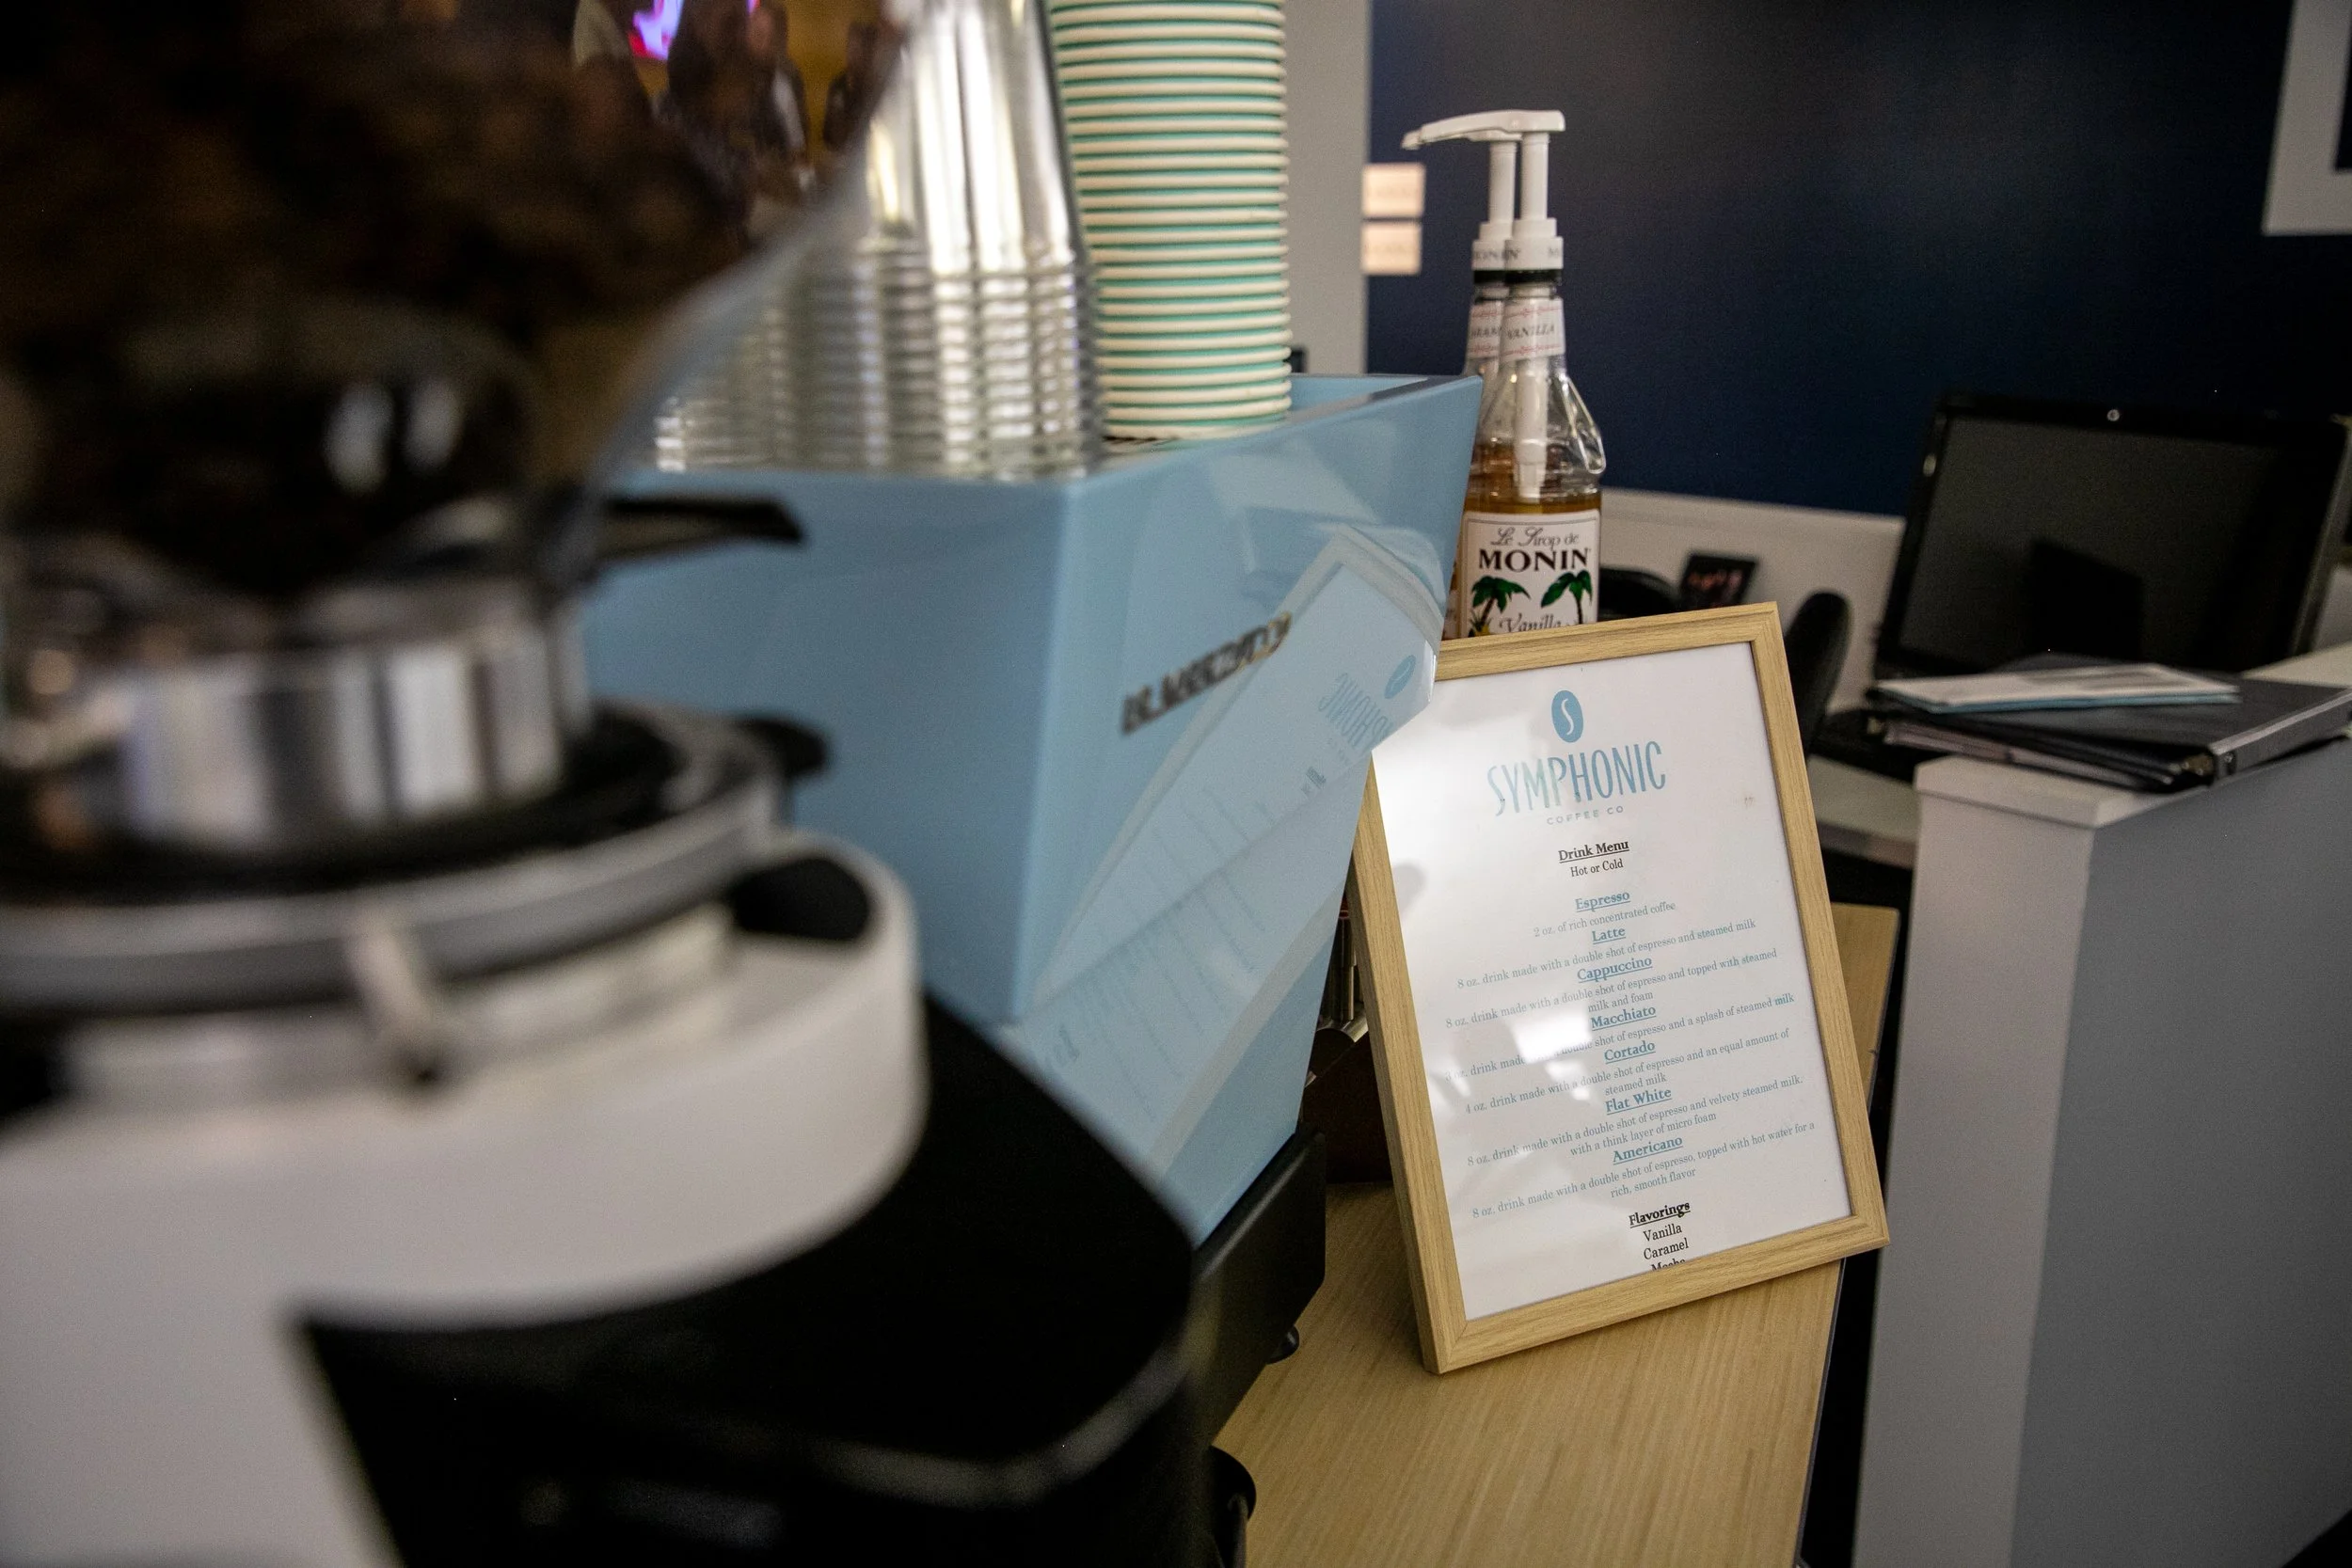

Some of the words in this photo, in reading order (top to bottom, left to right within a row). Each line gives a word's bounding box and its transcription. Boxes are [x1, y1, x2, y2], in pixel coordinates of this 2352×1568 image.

[1490, 526, 1516, 546] Le
[1518, 526, 1561, 549] Sirop
[1565, 532, 1580, 545] de
[1479, 548, 1588, 572] MONIN
[1486, 740, 1665, 816] SYMPHONIC
[1546, 809, 1600, 826] COFFEE
[1607, 805, 1624, 816] CO
[1557, 844, 1597, 864] Drink
[1595, 841, 1630, 858] Menu
[1569, 865, 1589, 878] Hot
[1589, 864, 1601, 874] or
[1601, 857, 1625, 872] Cold
[1574, 891, 1631, 913] Espresso
[1533, 927, 1541, 938] 2
[1541, 926, 1556, 936] oz.
[1556, 920, 1567, 933] of
[1567, 917, 1588, 931] rich
[1588, 904, 1649, 927] concentrated
[1649, 900, 1677, 914] coffee
[1591, 927, 1627, 945] Latte
[1456, 978, 1465, 990] 8
[1465, 978, 1481, 988] oz.
[1482, 969, 1511, 985] drink
[1511, 963, 1538, 978] made
[1539, 958, 1564, 972] with
[1563, 958, 1571, 968] a
[1571, 949, 1604, 966] double
[1605, 945, 1627, 958] shot
[1626, 942, 1637, 955] of
[1637, 937, 1677, 952] espresso
[1677, 929, 1696, 943] and
[1695, 922, 1735, 940] steamed
[1735, 917, 1757, 932] milk
[1576, 957, 1654, 984] Cappuccino
[1445, 1017, 1454, 1029] 8
[1453, 1017, 1470, 1027] oz.
[1470, 1007, 1500, 1023] drink
[1500, 1002, 1528, 1017] made
[1528, 996, 1552, 1011] with
[1552, 997, 1561, 1006] a
[1561, 988, 1596, 1005] double
[1594, 984, 1615, 997] shot
[1616, 979, 1627, 991] of
[1627, 974, 1667, 990] espresso
[1667, 966, 1686, 981] and
[1686, 959, 1719, 977] topped
[1718, 956, 1740, 969] with
[1740, 947, 1778, 965] steamed
[1587, 998, 1611, 1014] milk
[1611, 993, 1629, 1008] and
[1629, 991, 1654, 1004] foam
[1590, 1006, 1658, 1032] Macchiato
[1470, 1060, 1499, 1076] drink
[1594, 1034, 1616, 1048] shot
[1615, 1030, 1627, 1042] of
[1627, 1023, 1667, 1040] espresso
[1668, 1016, 1687, 1031] and
[1686, 1017, 1694, 1026] a
[1694, 1008, 1724, 1025] splash
[1724, 1005, 1735, 1017] of
[1735, 996, 1773, 1015] steamed
[1773, 992, 1795, 1006] milk
[1603, 1039, 1657, 1065] Cortado
[1472, 1101, 1488, 1113] oz.
[1489, 1092, 1518, 1109] drink
[1518, 1085, 1547, 1102] made
[1547, 1080, 1570, 1095] with
[1580, 1070, 1612, 1086] double
[1613, 1066, 1634, 1079] shot
[1634, 1061, 1645, 1074] of
[1645, 1054, 1685, 1071] espresso
[1686, 1047, 1705, 1062] and
[1705, 1047, 1719, 1057] an
[1719, 1037, 1744, 1054] equal
[1744, 1031, 1779, 1048] amount
[1780, 1026, 1790, 1039] of
[1604, 1076, 1645, 1097] steamed
[1645, 1071, 1668, 1086] milk
[1604, 1097, 1634, 1117] Flat
[1631, 1088, 1673, 1110] White
[1467, 1155, 1475, 1167] 8
[1474, 1154, 1491, 1165] oz.
[1491, 1144, 1519, 1162] drink
[1522, 1137, 1549, 1153] made
[1549, 1131, 1574, 1146] with
[1573, 1132, 1582, 1141] a
[1582, 1120, 1615, 1138] double
[1615, 1117, 1637, 1130] shot
[1637, 1111, 1648, 1124] of
[1648, 1104, 1689, 1122] espresso
[1689, 1097, 1708, 1112] and
[1708, 1091, 1740, 1106] velvety
[1741, 1079, 1779, 1099] steamed
[1569, 1141, 1593, 1156] with
[1594, 1142, 1601, 1151] a
[1602, 1132, 1629, 1148] think
[1629, 1128, 1655, 1142] layer
[1655, 1121, 1665, 1134] of
[1665, 1118, 1693, 1132] micro
[1693, 1113, 1717, 1125] foam
[1613, 1136, 1684, 1166] Americano
[1471, 1207, 1480, 1219] 8
[1480, 1206, 1496, 1217] oz.
[1497, 1196, 1526, 1212] drink
[1527, 1189, 1555, 1205] made
[1555, 1182, 1579, 1197] with
[1580, 1181, 1587, 1191] a
[1587, 1171, 1620, 1189] double
[1621, 1165, 1643, 1180] shot
[1643, 1161, 1653, 1174] of
[1654, 1154, 1696, 1171] espresso,
[1696, 1142, 1728, 1160] topped
[1728, 1136, 1751, 1151] with
[1750, 1133, 1767, 1146] hot
[1767, 1126, 1793, 1141] water
[1794, 1122, 1808, 1134] for
[1808, 1121, 1816, 1131] a
[1610, 1183, 1632, 1199] rich,
[1632, 1173, 1669, 1192] smooth
[1668, 1167, 1696, 1182] flavor
[1628, 1202, 1692, 1229] Flavorings
[1642, 1222, 1683, 1243] Vanilla
[1643, 1236, 1690, 1260] Caramel
